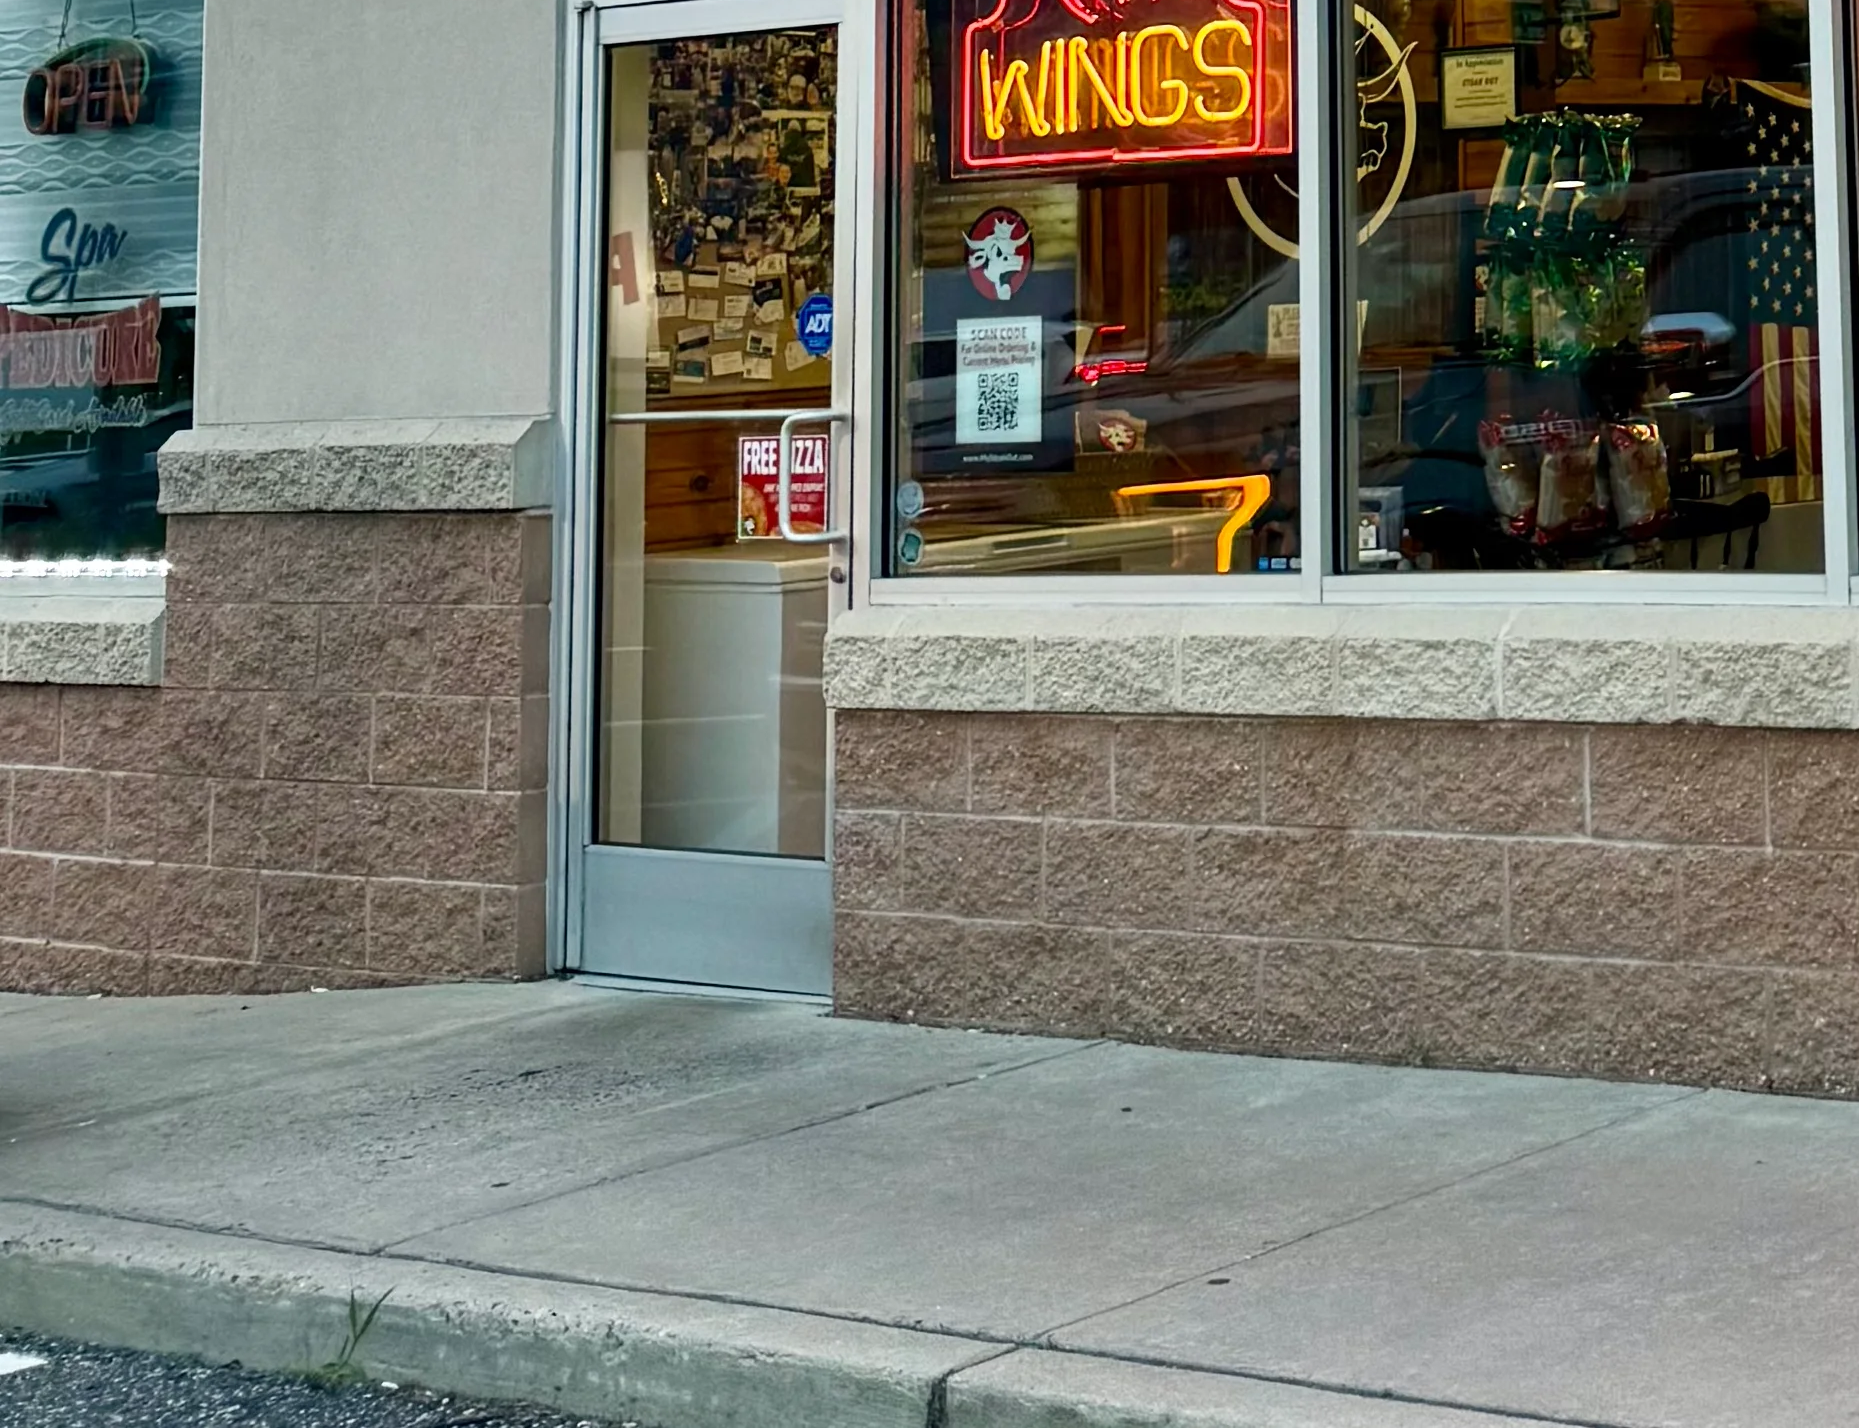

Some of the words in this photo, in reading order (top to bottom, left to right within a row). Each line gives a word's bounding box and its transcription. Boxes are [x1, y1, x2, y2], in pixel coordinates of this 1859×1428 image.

[23, 58, 139, 135] OPEN
[979, 19, 1254, 140] WINGS
[26, 207, 127, 305] Spa
[805, 313, 831, 333] ADT
[971, 328, 998, 341] SCAN
[1000, 326, 1027, 340] CODE
[743, 440, 778, 475] FREE
[791, 438, 824, 474] IZZA
